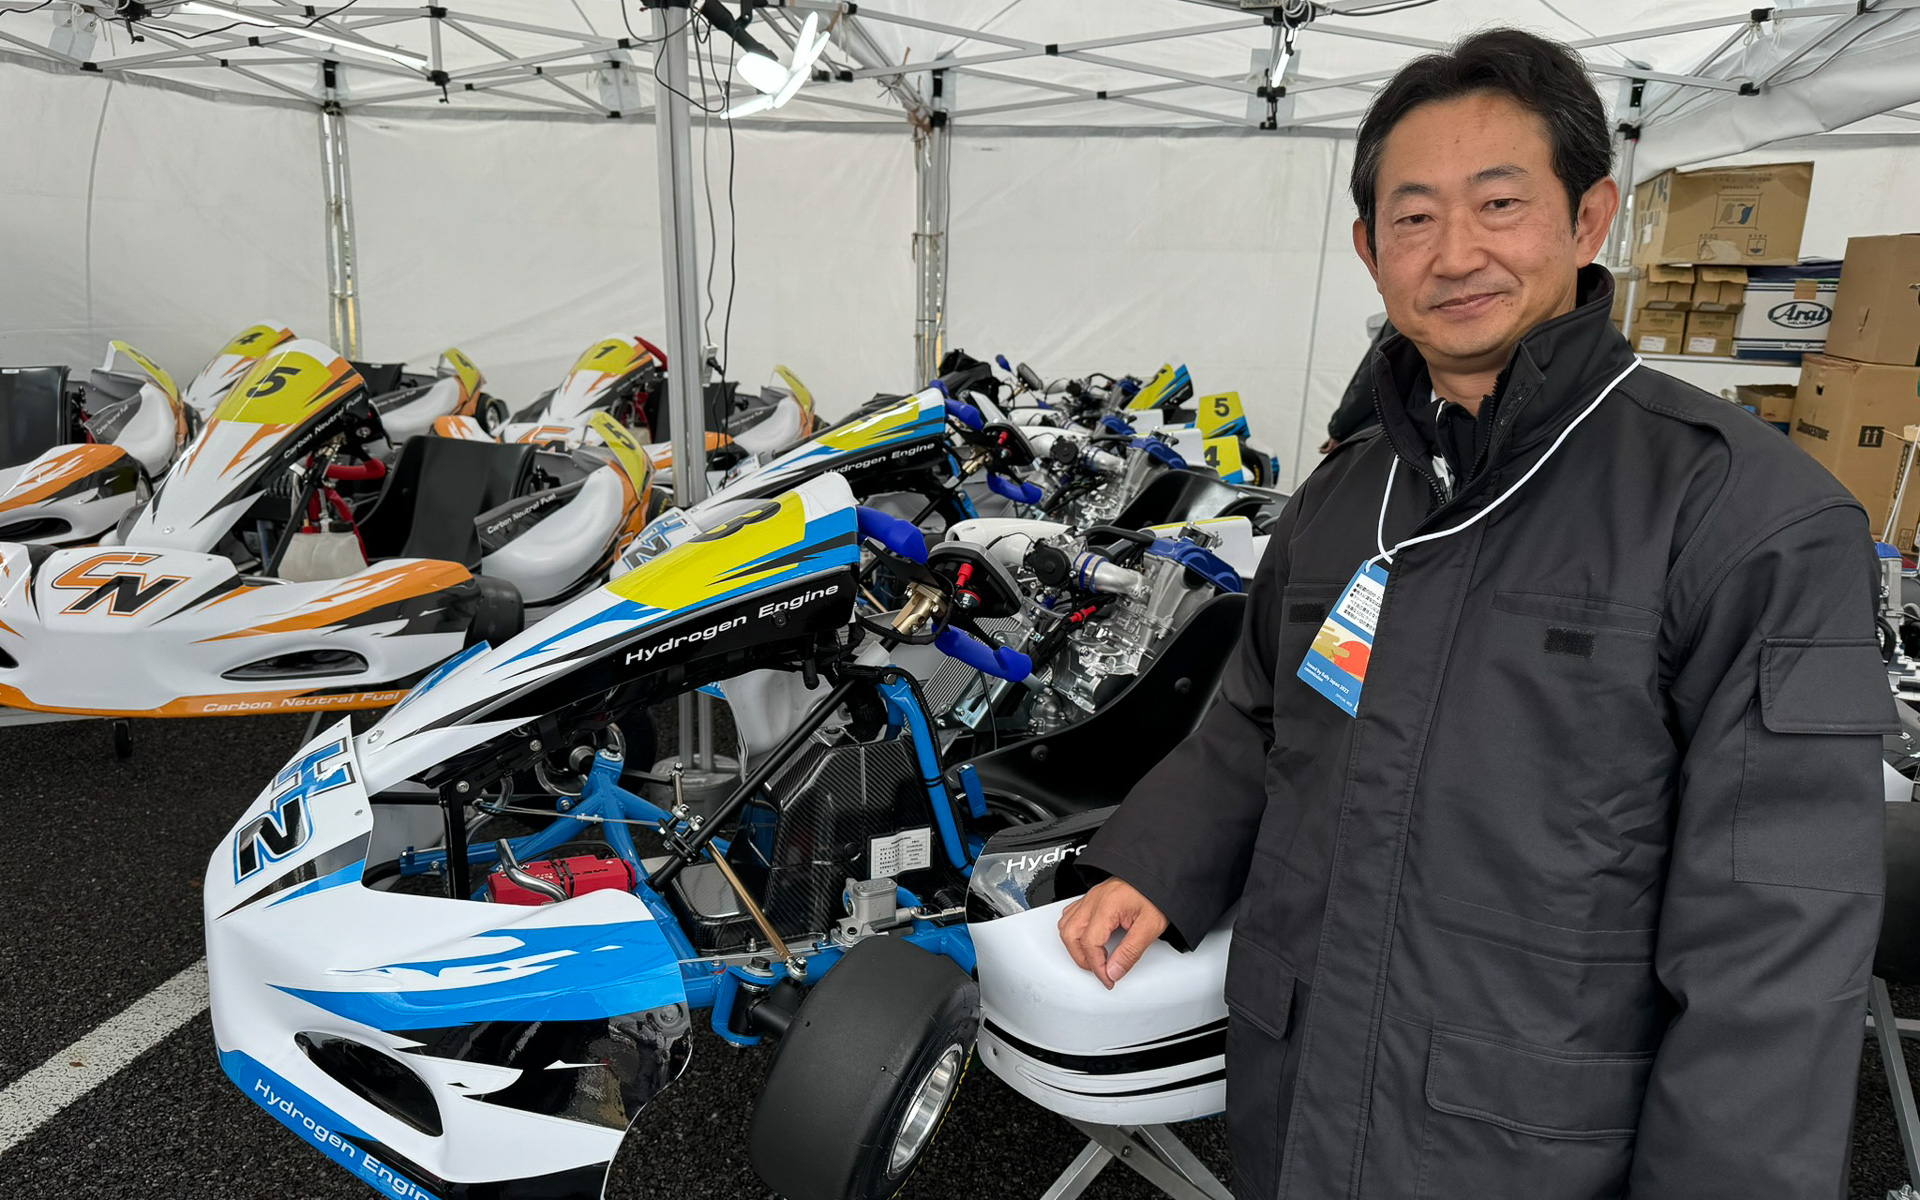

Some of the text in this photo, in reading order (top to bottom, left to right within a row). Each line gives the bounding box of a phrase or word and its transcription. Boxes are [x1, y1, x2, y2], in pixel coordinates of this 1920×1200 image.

[1773, 304, 1827, 321] Arai
[594, 345, 618, 359] 1
[246, 366, 302, 398] 5
[1214, 397, 1230, 417] 5
[284, 434, 313, 459] Carbon
[314, 407, 345, 435] Neutral
[603, 422, 637, 450] 5
[891, 442, 935, 459] Engine
[1204, 446, 1220, 468] 4
[487, 493, 557, 534] Carbon Neutral Fuel
[51, 551, 192, 617] CN
[625, 584, 839, 665] Hydrogen Engine
[203, 691, 400, 713] Carbon Neutral Fuel
[253, 1078, 356, 1159] Hydrogen
